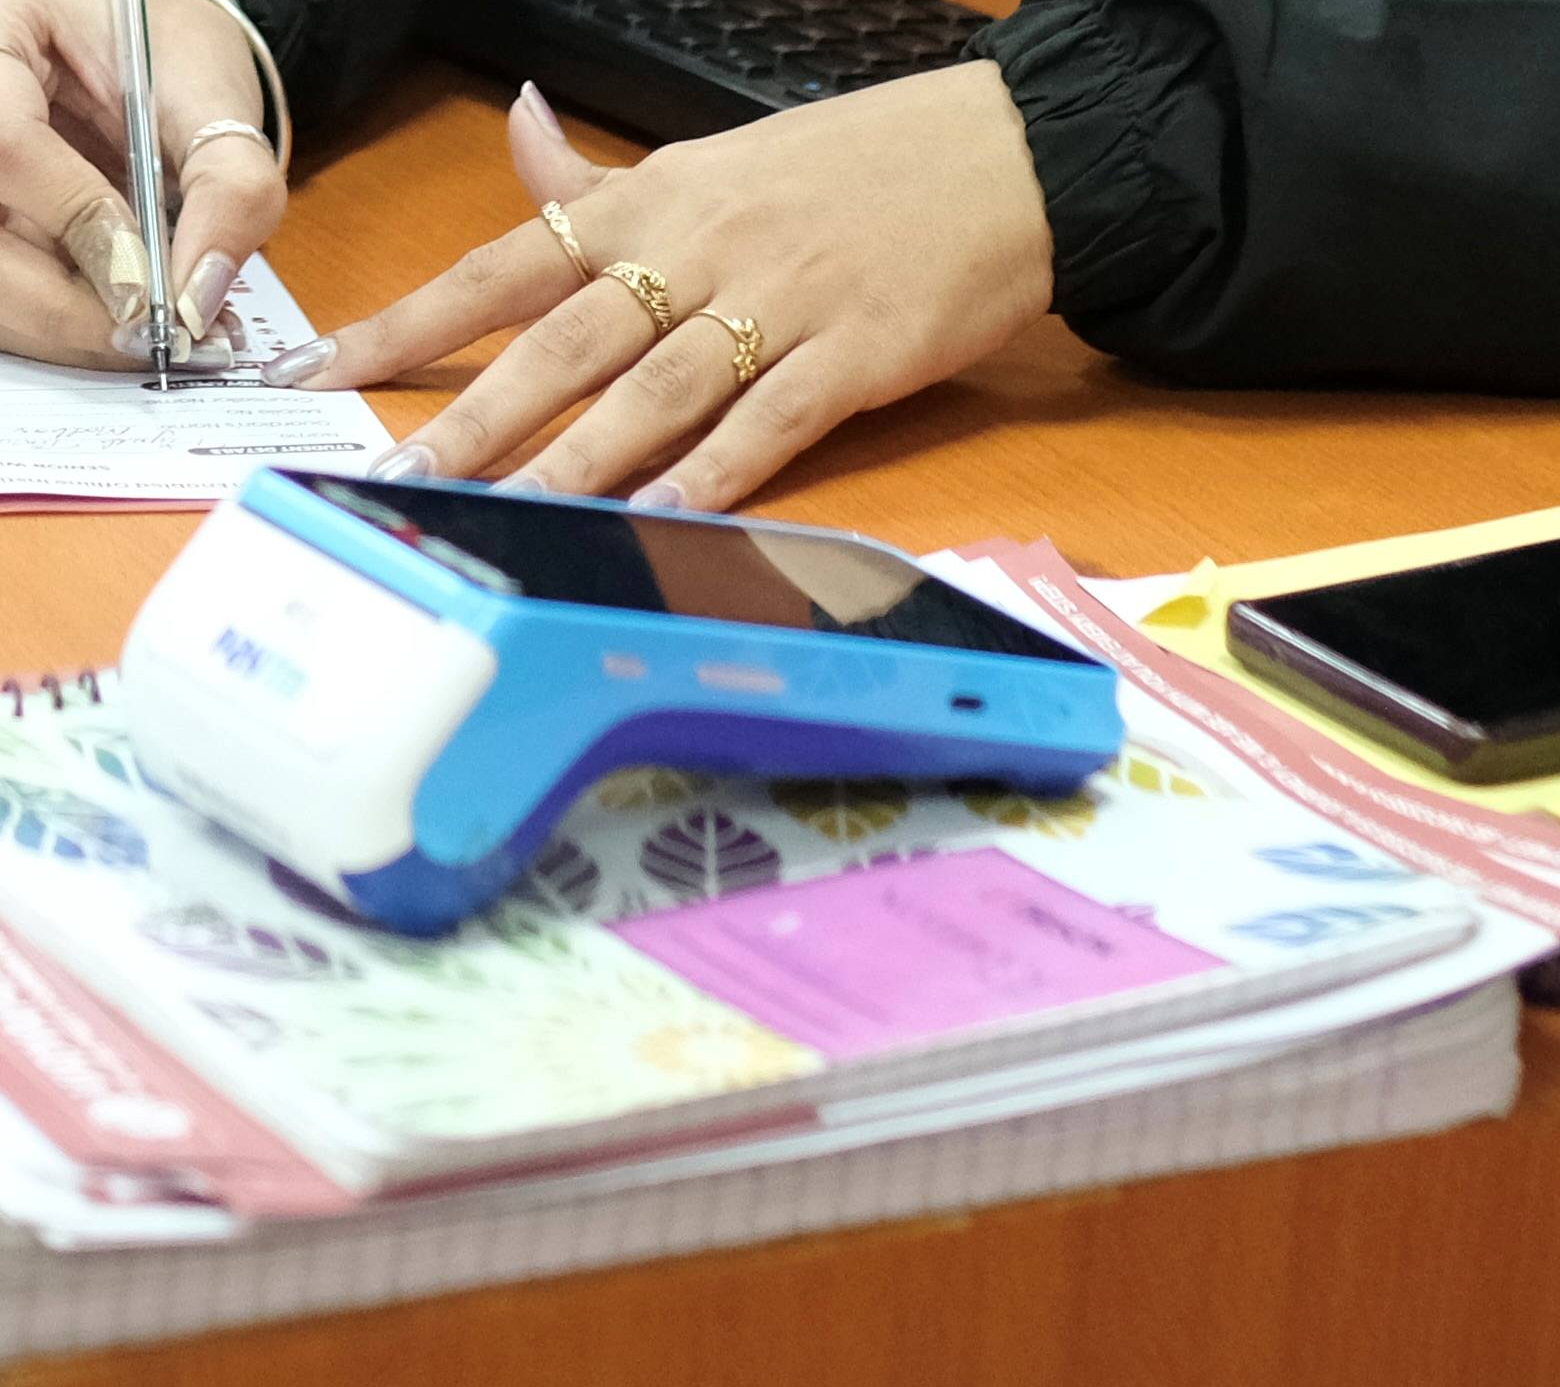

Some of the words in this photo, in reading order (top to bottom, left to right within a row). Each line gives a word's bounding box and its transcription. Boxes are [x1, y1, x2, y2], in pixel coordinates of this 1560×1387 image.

[208, 446, 279, 456] DETAILS
[280, 444, 356, 453] STUDENT
[32, 463, 111, 471] SENIOR
